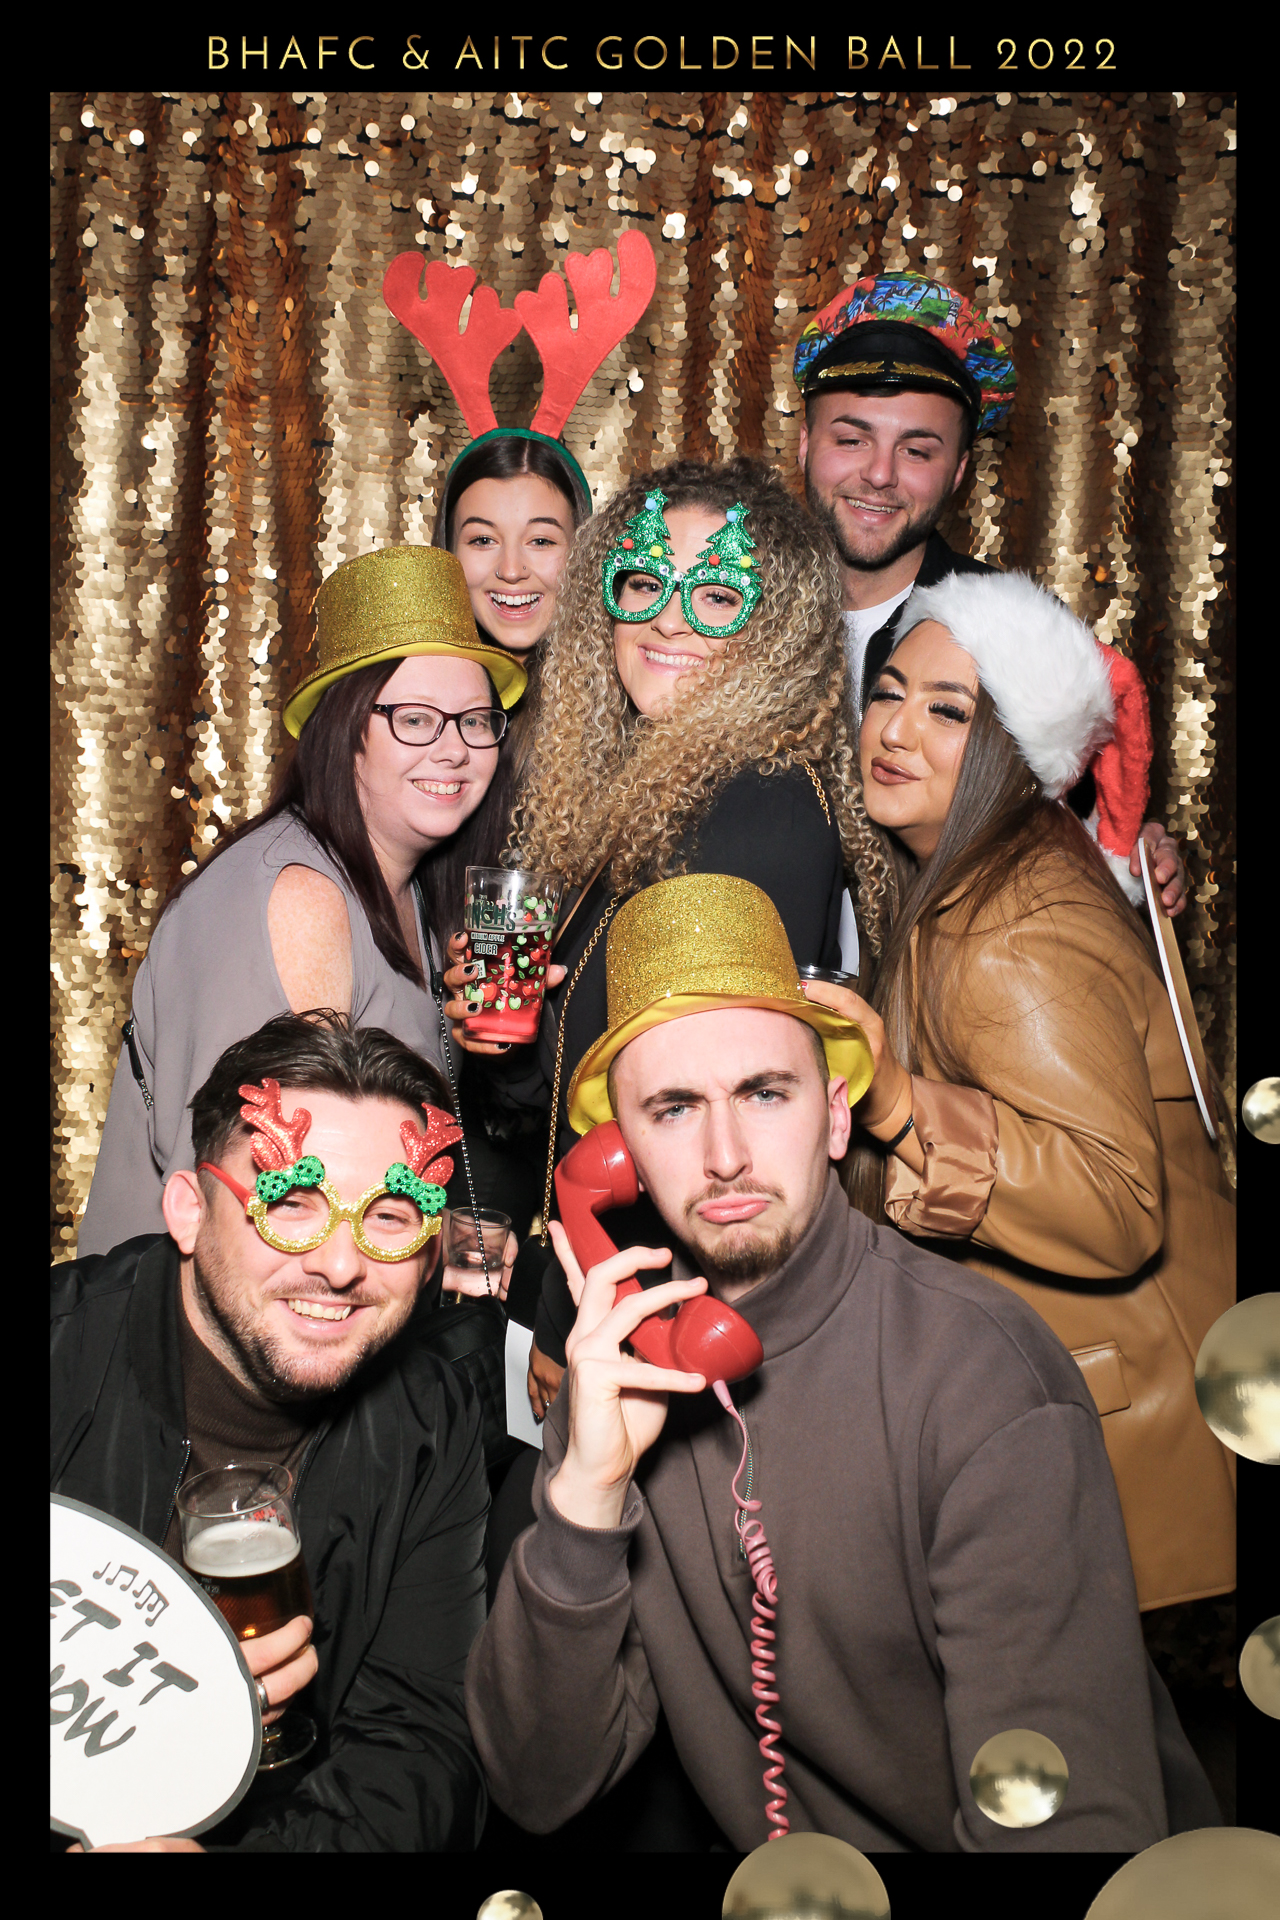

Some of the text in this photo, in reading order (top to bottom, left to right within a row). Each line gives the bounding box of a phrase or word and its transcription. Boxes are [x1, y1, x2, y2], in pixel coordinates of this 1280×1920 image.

[474, 942, 498, 956] CIDER
[50, 1579, 199, 1706] ET IT
[50, 1663, 136, 1757] OW
